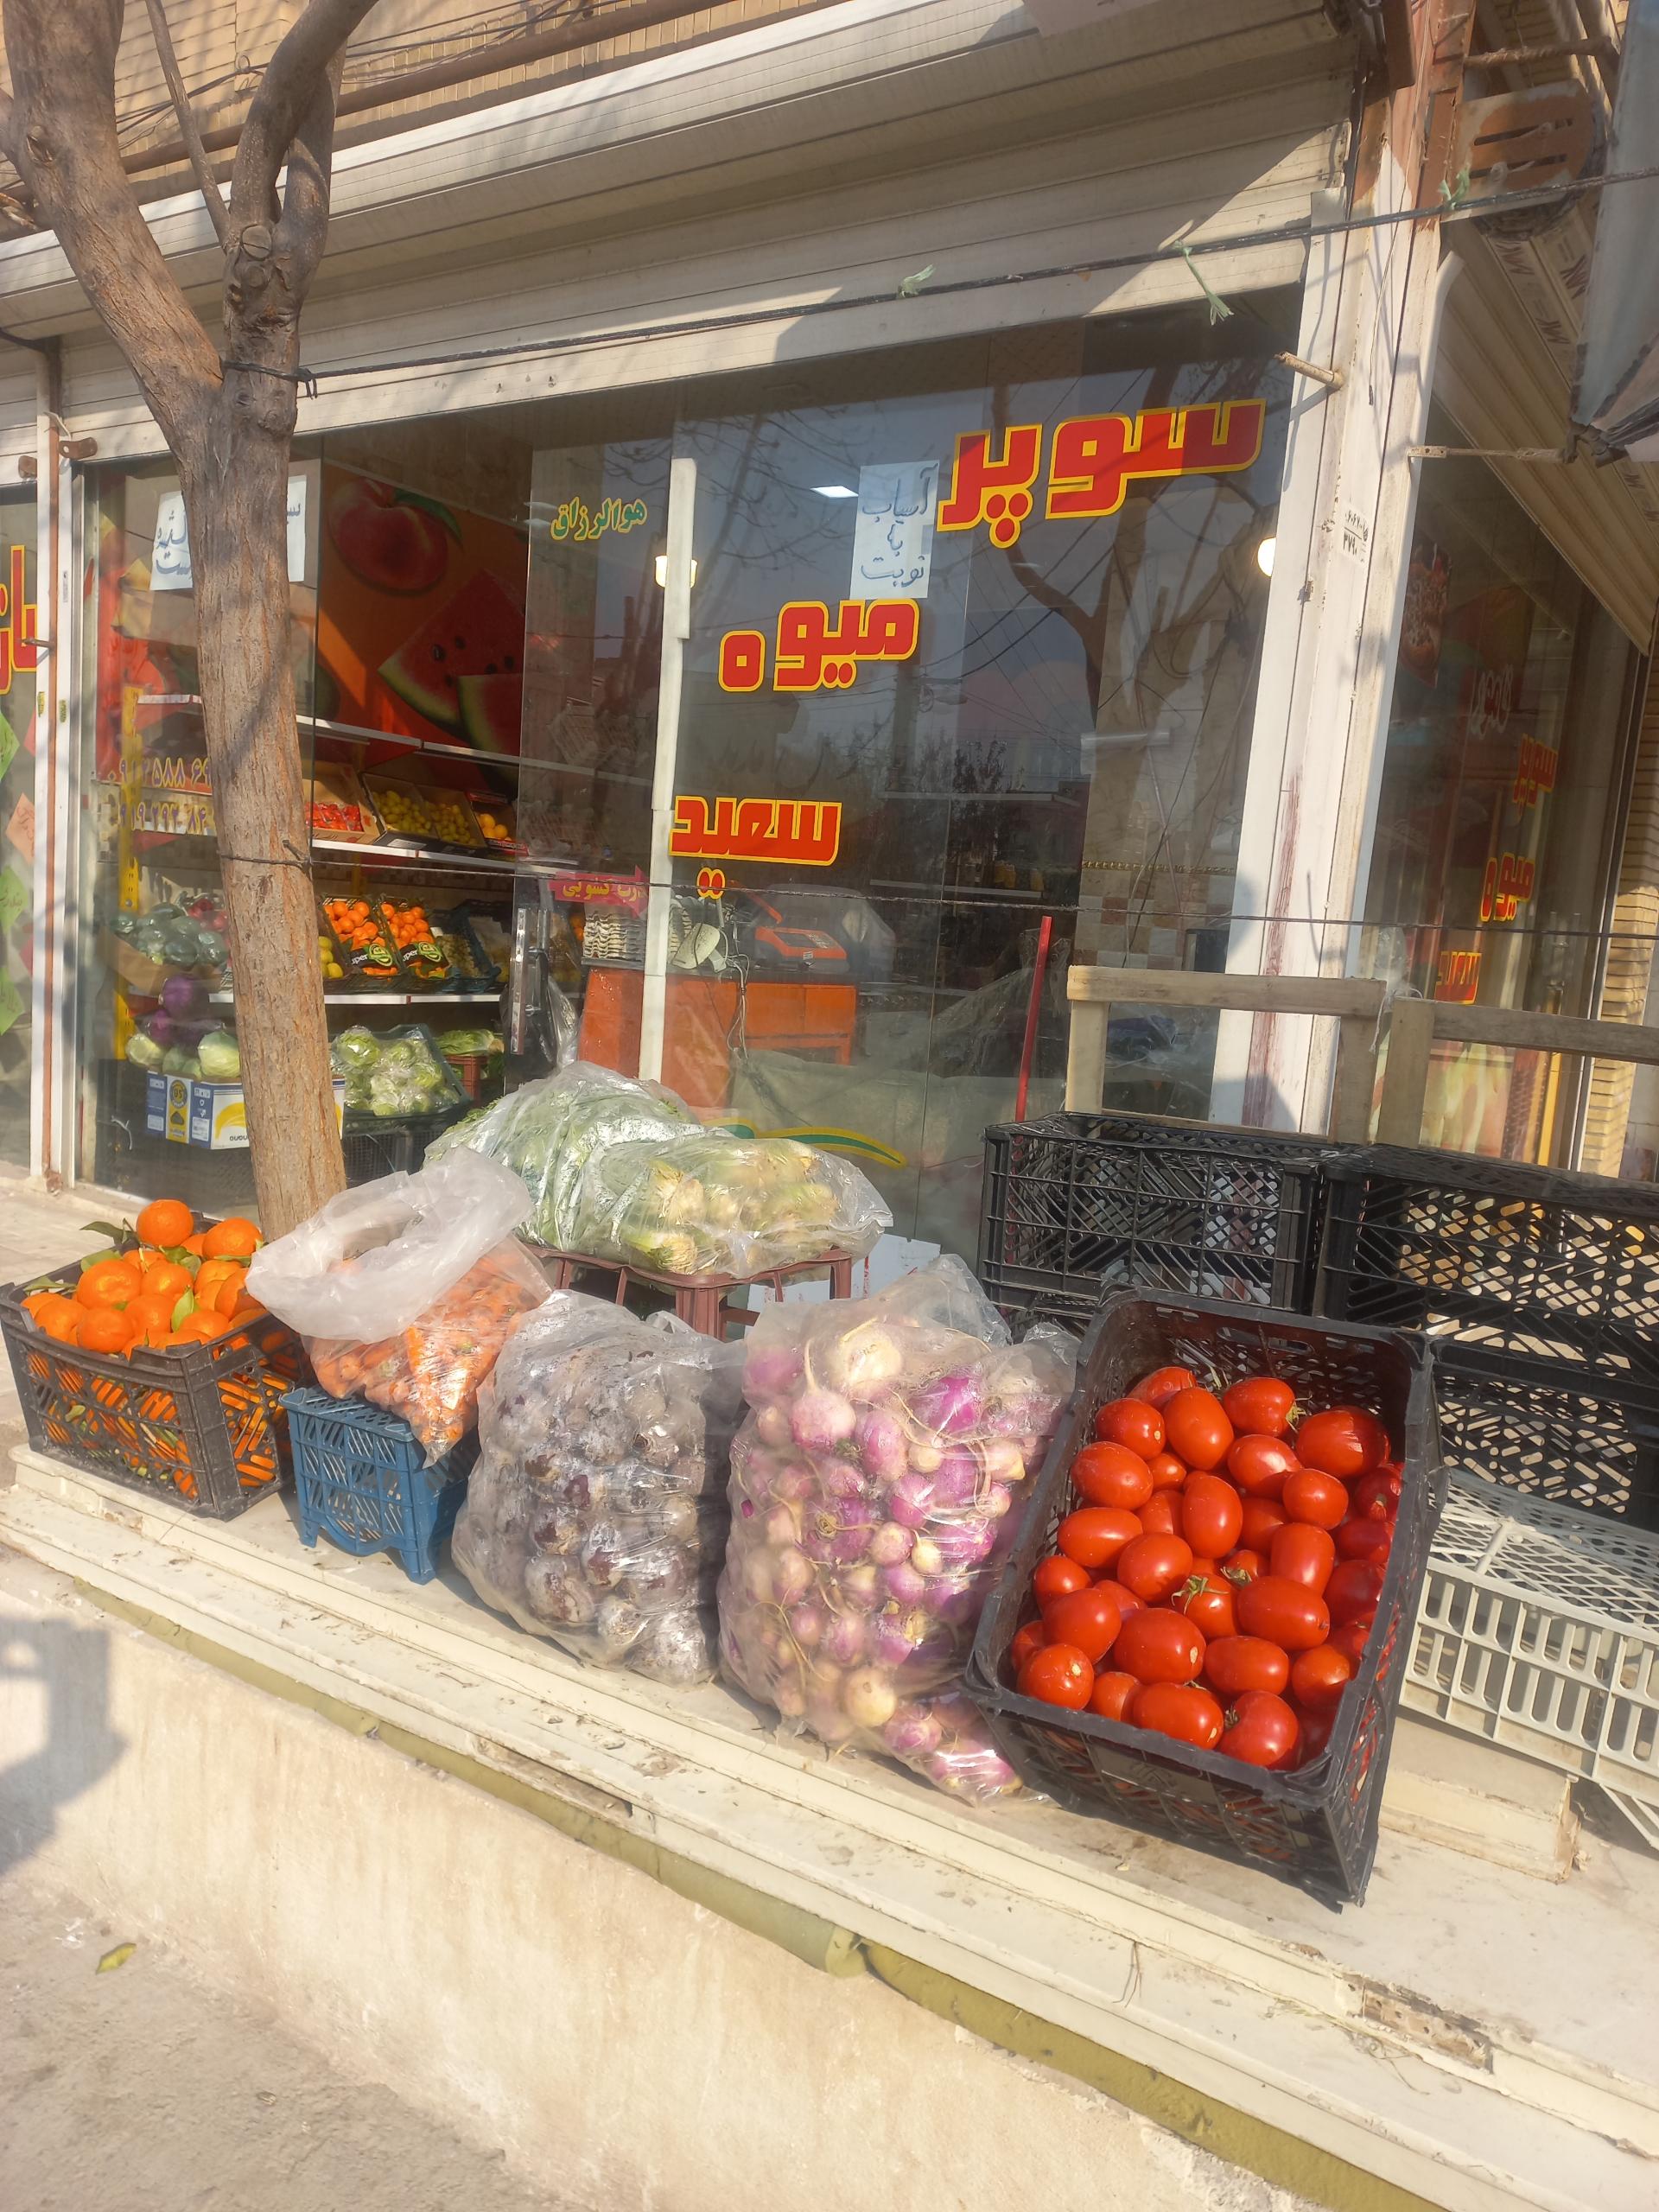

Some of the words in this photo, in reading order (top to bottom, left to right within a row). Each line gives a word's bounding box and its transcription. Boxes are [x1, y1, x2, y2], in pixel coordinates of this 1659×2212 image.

[937, 398, 1267, 550] سوپر
[718, 598, 920, 692] میوه
[1512, 733, 1559, 826] سوپر
[669, 795, 842, 899] سعید
[1478, 851, 1535, 923] میوه
